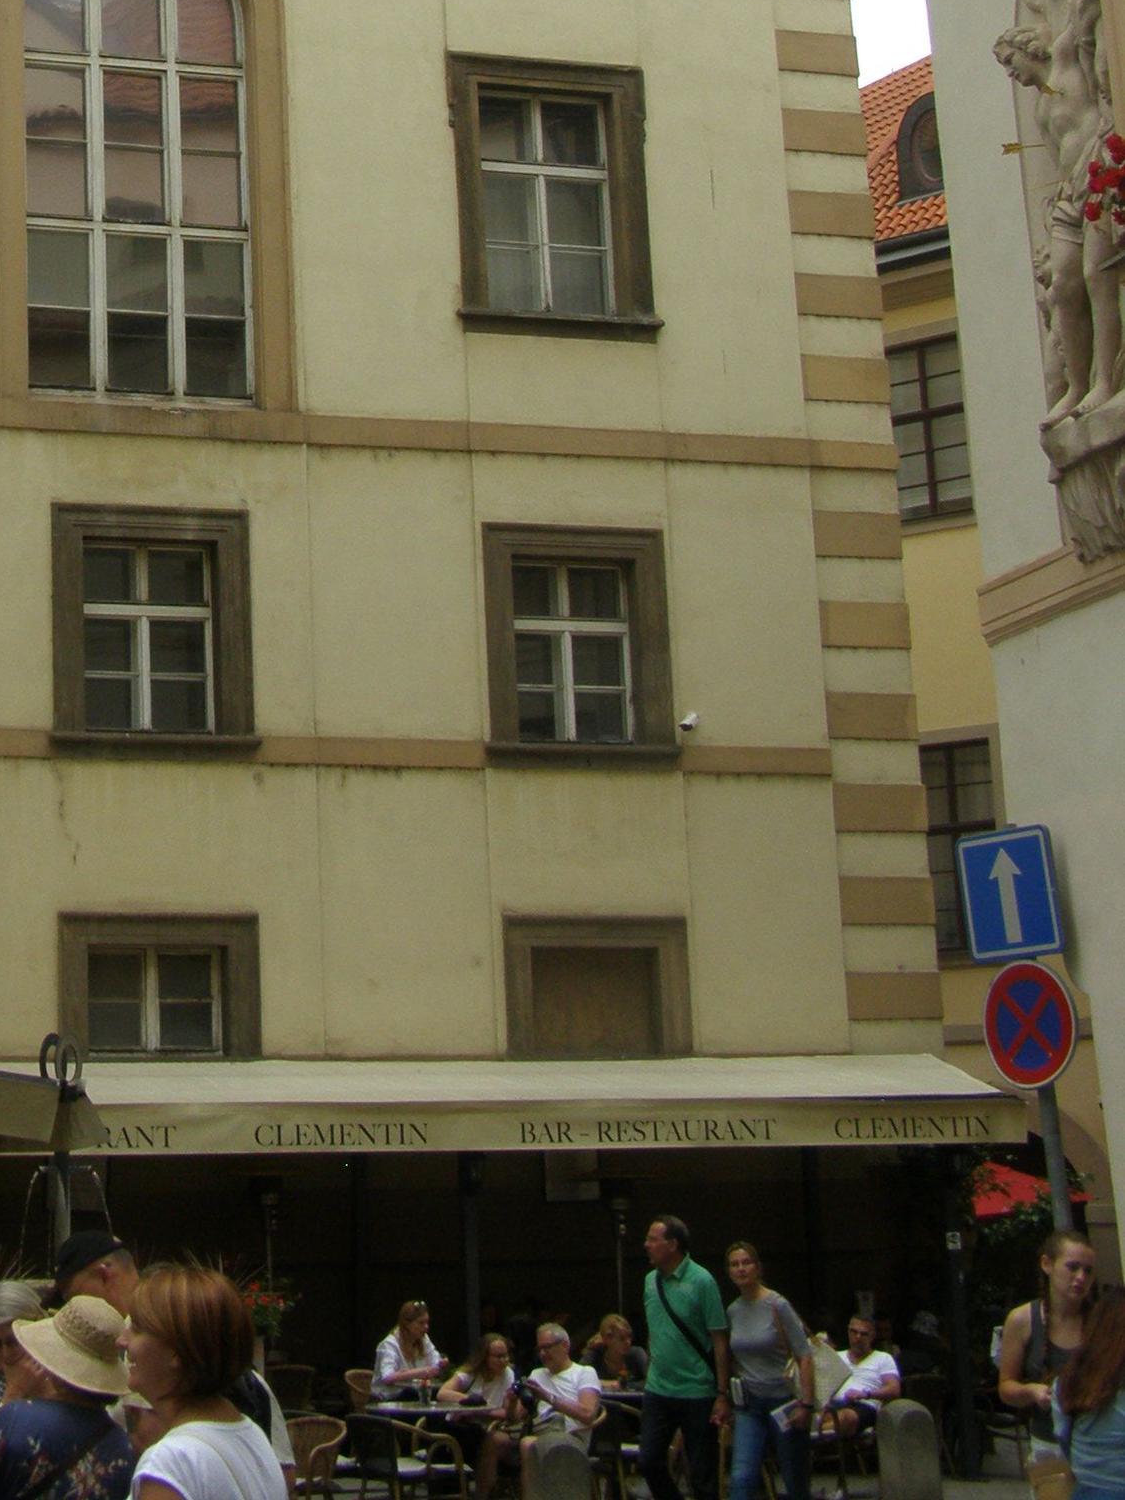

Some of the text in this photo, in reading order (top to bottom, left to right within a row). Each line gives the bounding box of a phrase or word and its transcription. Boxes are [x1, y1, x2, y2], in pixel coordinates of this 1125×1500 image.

[254, 1123, 428, 1147] CLEMENTIN
[520, 1121, 574, 1143] BAR
[597, 1118, 777, 1142] RESTAURANT
[834, 1115, 990, 1139] CLEMENTIN
